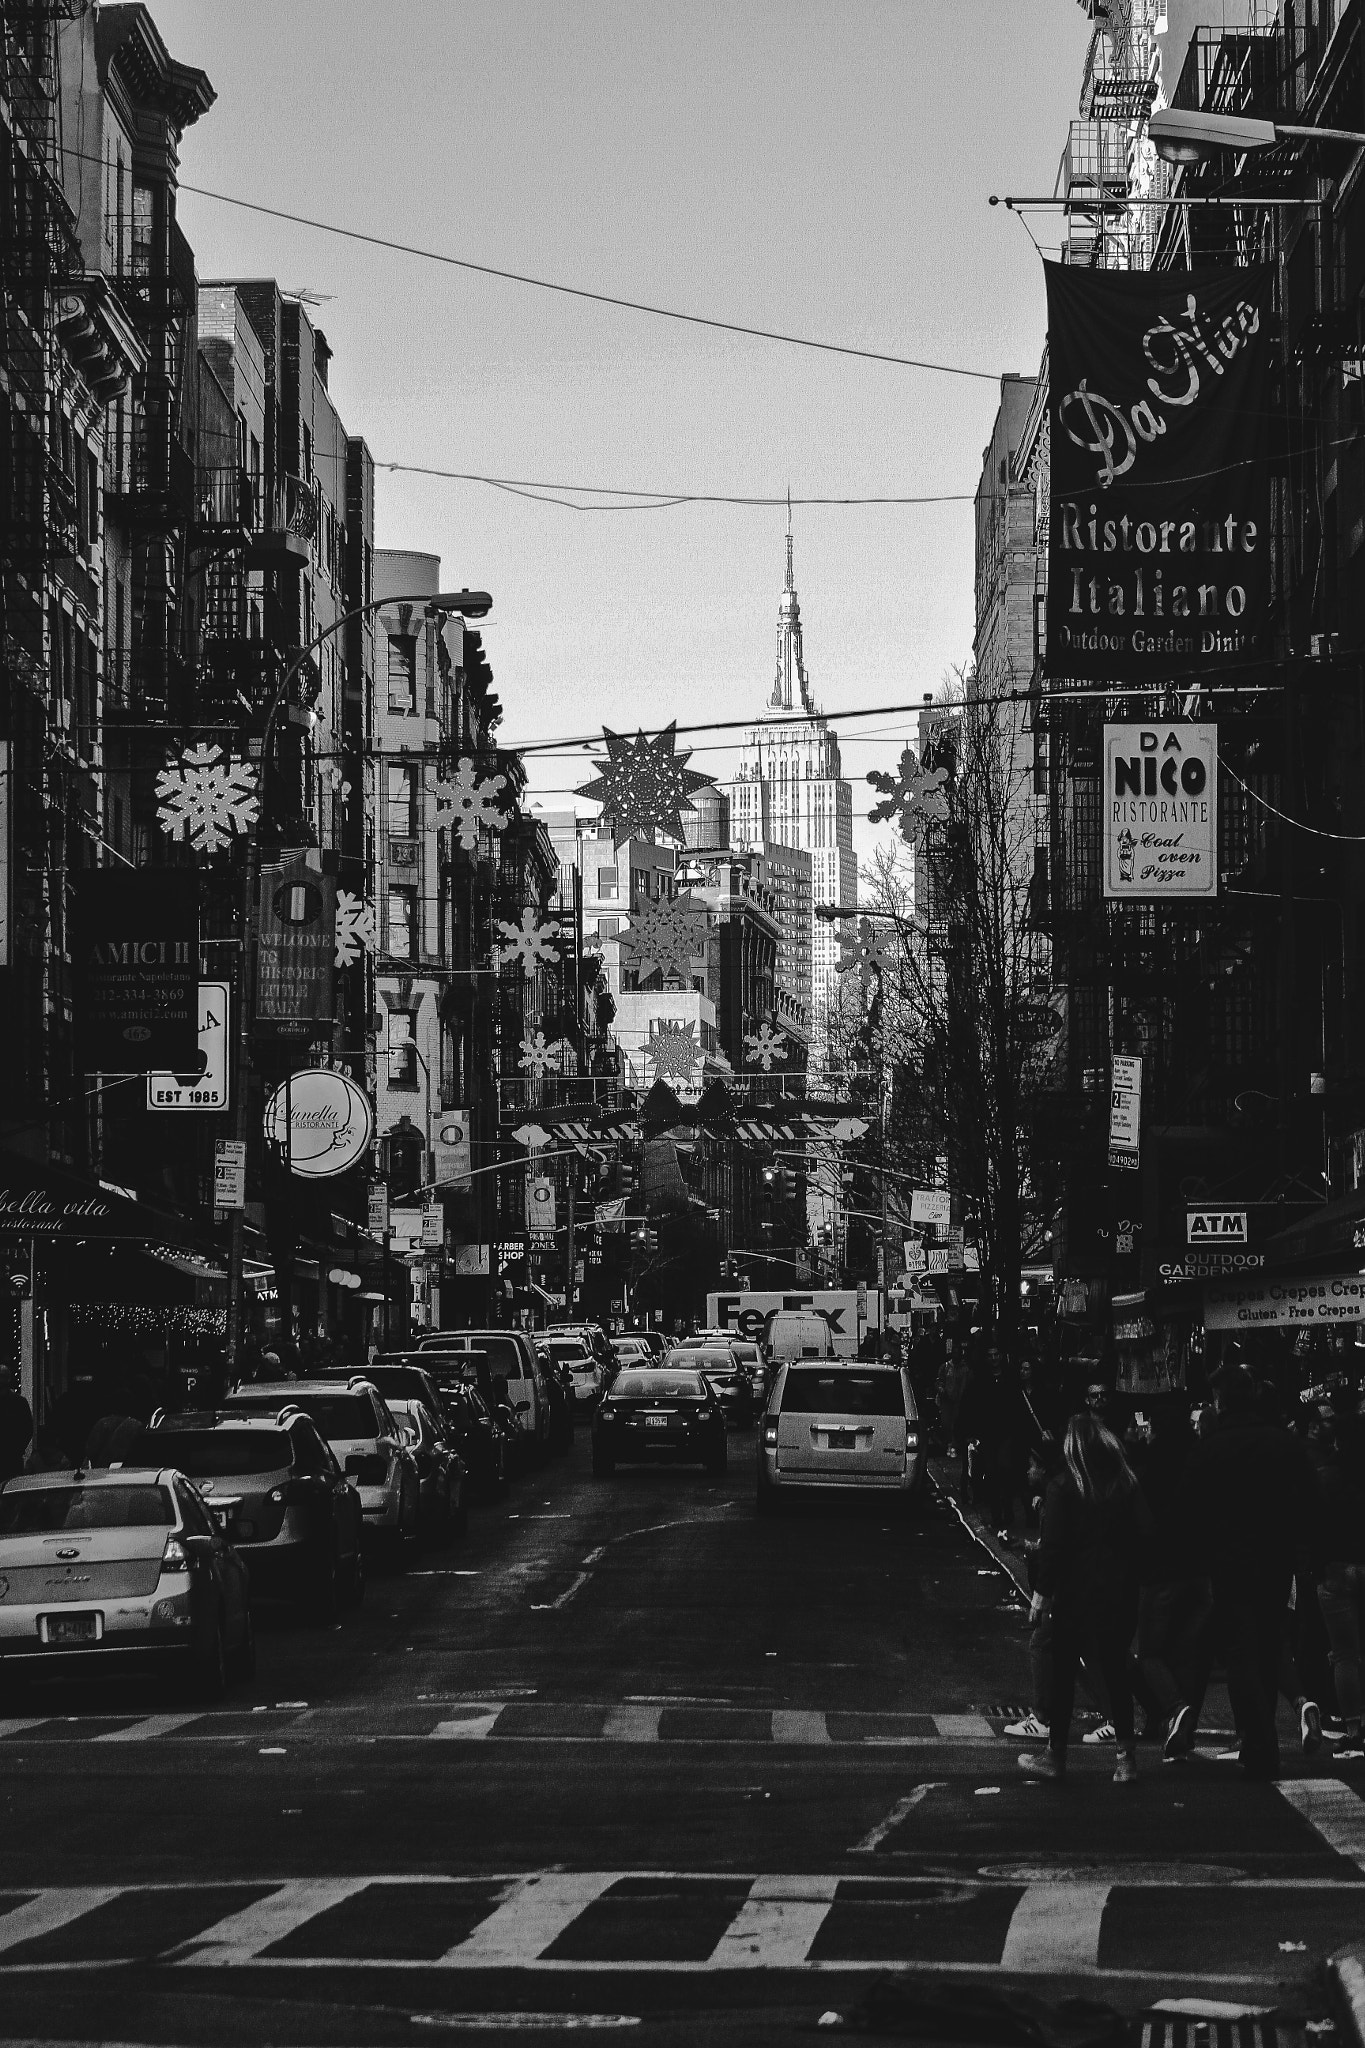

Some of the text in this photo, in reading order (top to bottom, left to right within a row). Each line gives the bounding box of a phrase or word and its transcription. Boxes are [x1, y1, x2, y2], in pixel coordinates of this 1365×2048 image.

[1058, 293, 1260, 489] Da Nico
[1059, 502, 1258, 553] Ristorante
[1068, 566, 1247, 617] Italiano
[1059, 625, 1126, 651] Outdoor
[1132, 629, 1194, 652] Garden
[1139, 731, 1182, 752] DA
[1114, 756, 1207, 796] NICO
[1112, 801, 1209, 823] RISTORANTE
[1140, 832, 1185, 849] Coal
[1158, 851, 1202, 863] oven
[1140, 864, 1186, 883] Pizza
[260, 933, 331, 948] WELCOME
[88, 941, 190, 965] AMICI II
[260, 950, 279, 964] TO
[260, 966, 327, 981] HISTORIC
[260, 984, 309, 998] LITTLE
[259, 1000, 300, 1014] ITALY
[156, 1091, 219, 1103] EST 1985
[63, 1198, 111, 1216] vita
[1190, 1215, 1244, 1233] ATM
[531, 1241, 556, 1249] JONES
[498, 1251, 525, 1260] SHOP
[257, 1289, 279, 1301] ATM
[1269, 1283, 1326, 1302] Crepes
[1237, 1308, 1278, 1321] Gluten
[1288, 1306, 1315, 1318] Free
[1317, 1303, 1361, 1320] Crepes
